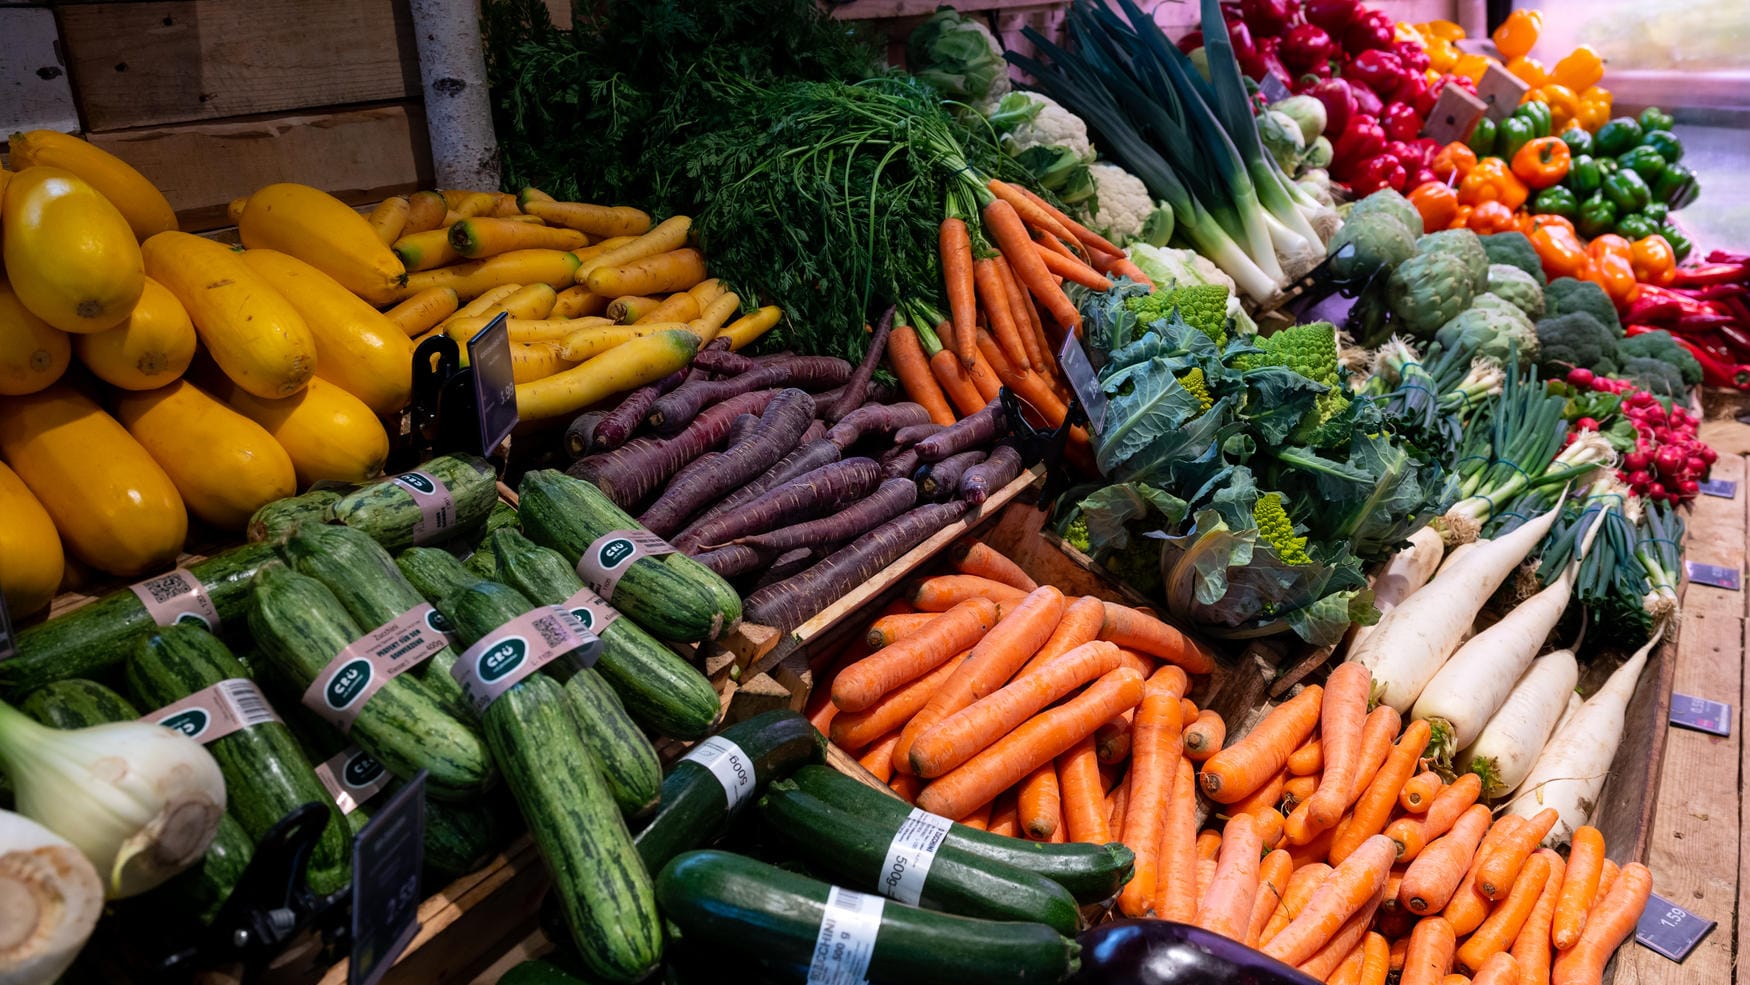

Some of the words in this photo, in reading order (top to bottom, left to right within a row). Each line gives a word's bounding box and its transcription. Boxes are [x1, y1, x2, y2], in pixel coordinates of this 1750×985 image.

[605, 542, 624, 557] CRÜ
[373, 624, 399, 641] Zucchini
[486, 645, 514, 668] CRÜ
[334, 668, 358, 694] CRÜ
[729, 755, 748, 786] 500g
[886, 855, 908, 887] 500g
[1661, 907, 1687, 928] 1.59
[840, 931, 851, 940] g
